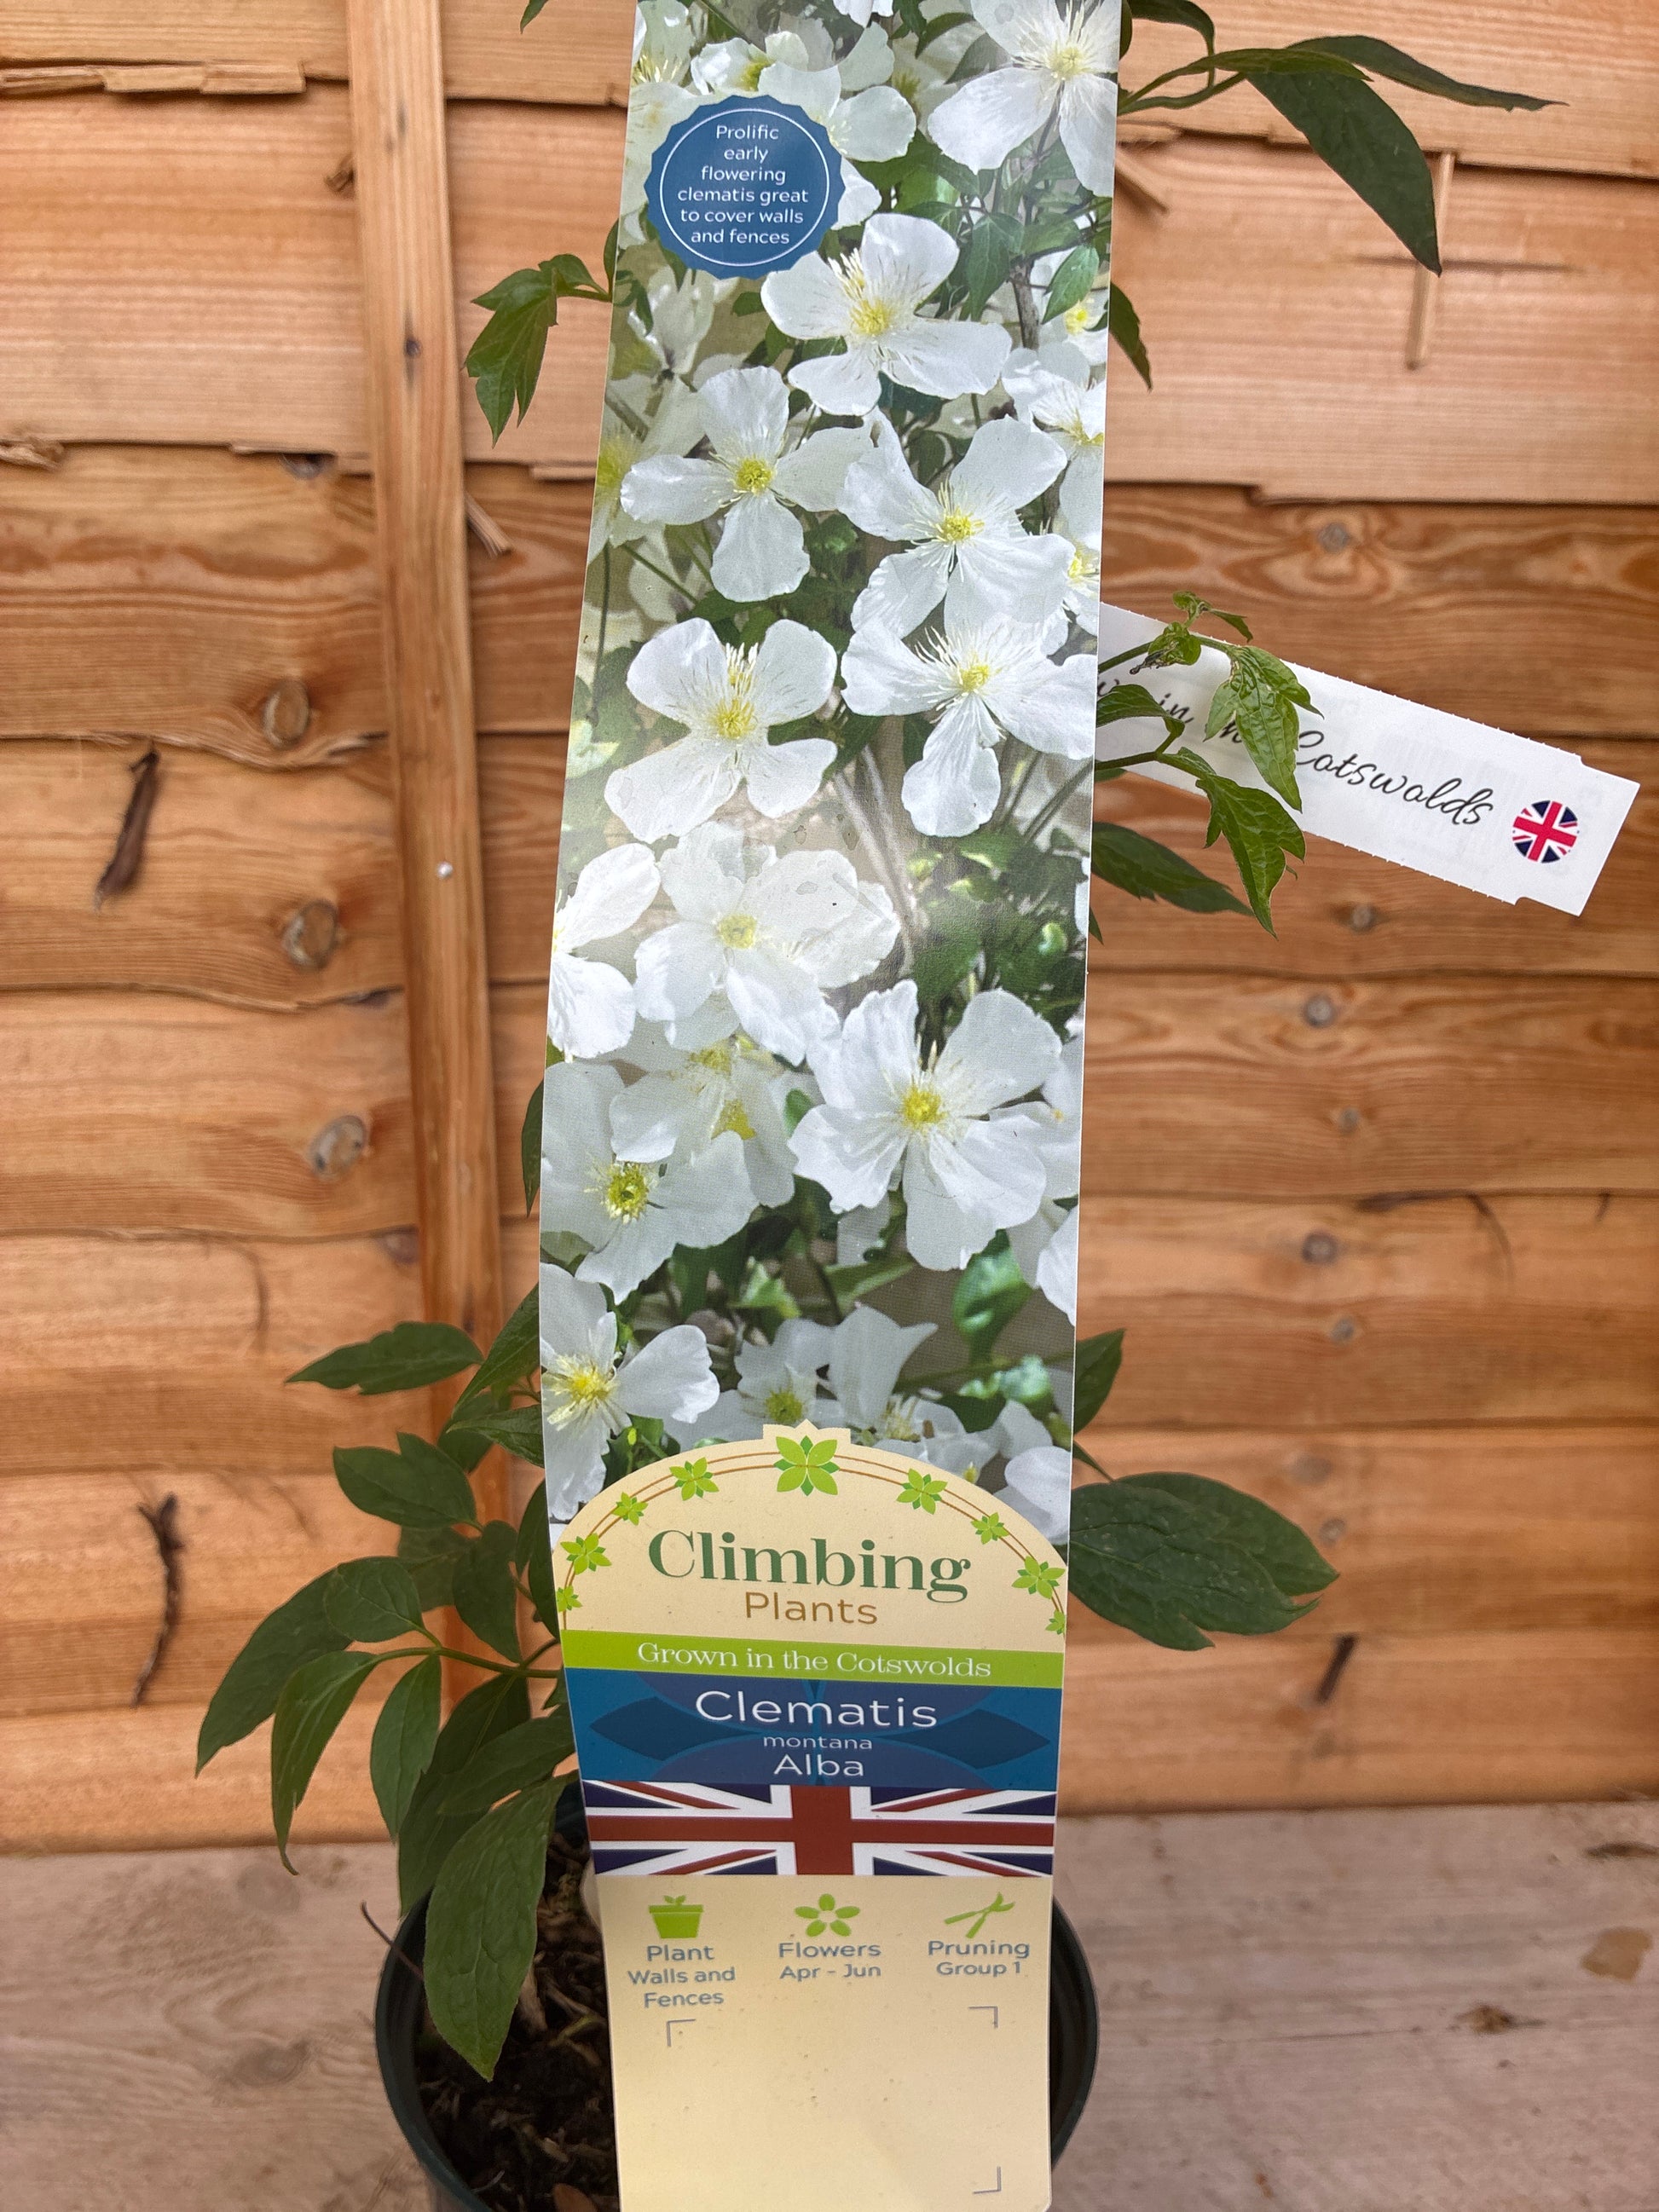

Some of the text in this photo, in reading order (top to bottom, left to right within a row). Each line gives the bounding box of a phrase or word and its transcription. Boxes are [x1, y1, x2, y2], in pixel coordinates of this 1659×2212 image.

[715, 124, 780, 141] Prolific
[723, 145, 770, 164] early
[701, 165, 787, 186] flowering
[677, 186, 809, 206] clematis great
[680, 208, 804, 225] to cover walls
[691, 228, 790, 245] and fences
[648, 1529, 972, 1604] Climbing
[744, 1591, 879, 1626] Plants
[637, 1642, 992, 1678] Grown in the Cotswolds
[695, 1689, 939, 1729] Clematis
[762, 1736, 873, 1751] montana
[772, 1753, 865, 1778] Alba
[646, 1944, 714, 1962] Plant
[778, 1941, 882, 1959] Flowers
[928, 1940, 1031, 1960] Pruning
[627, 1965, 736, 1986] Walls and
[779, 1964, 821, 1982] Apr
[842, 1962, 882, 1979] Jun
[936, 1960, 1022, 1978] Group 1
[644, 1990, 725, 2009] Fences
